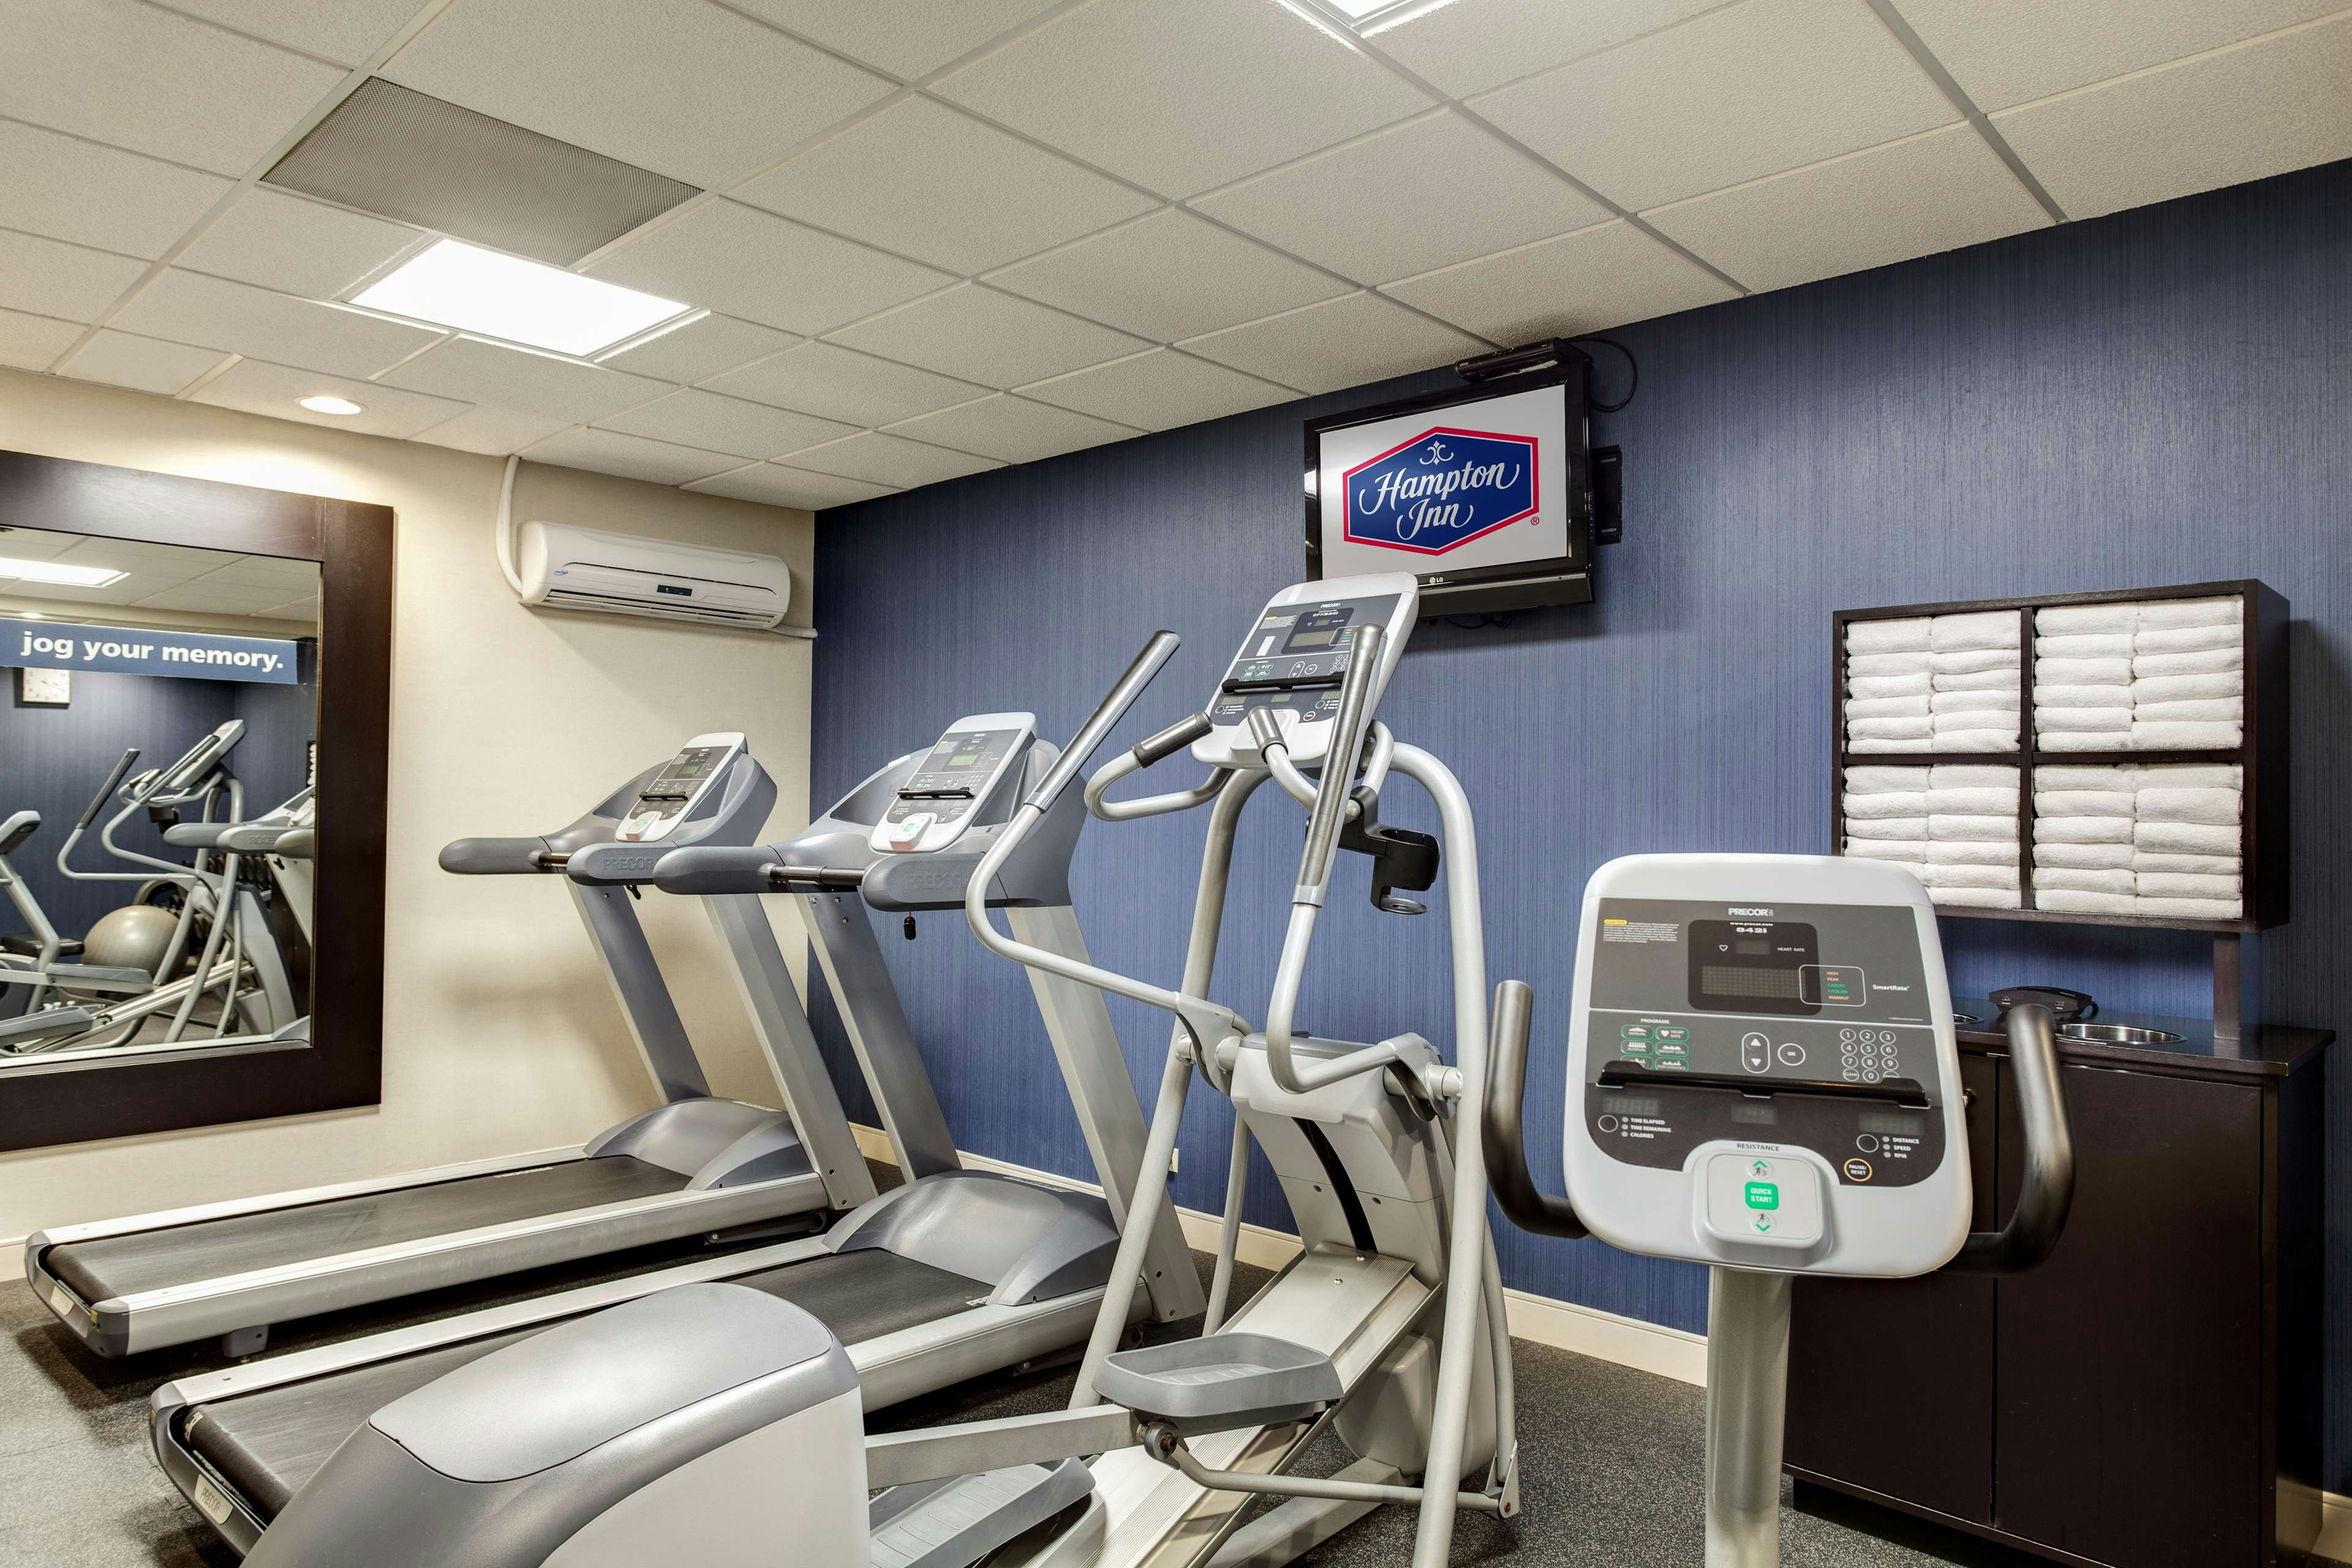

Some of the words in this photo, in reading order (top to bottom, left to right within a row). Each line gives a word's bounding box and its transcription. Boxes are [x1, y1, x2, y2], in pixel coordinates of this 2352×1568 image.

[1359, 460, 1520, 515] Hampton
[1396, 497, 1474, 540] Inn
[20, 631, 74, 658] jog
[83, 639, 154, 661] your
[162, 645, 284, 672] memory.
[1728, 908, 1769, 917] PRECOR
[1736, 1143, 1780, 1152] RESISTANCE
